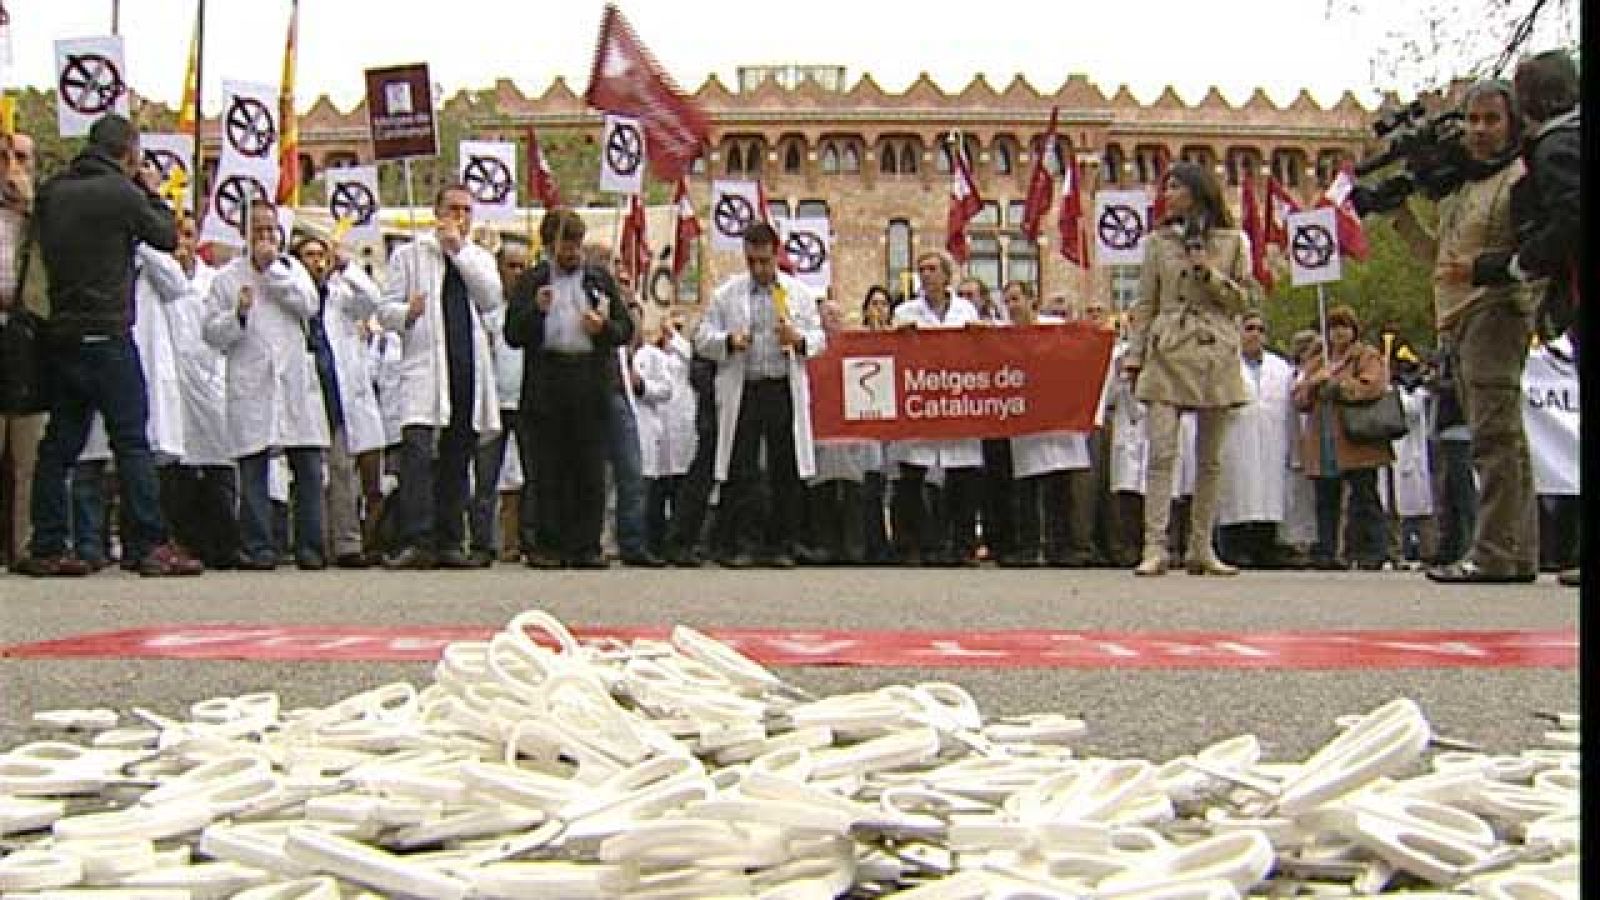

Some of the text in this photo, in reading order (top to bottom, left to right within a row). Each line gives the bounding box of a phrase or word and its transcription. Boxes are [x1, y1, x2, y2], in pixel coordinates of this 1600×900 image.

[904, 365, 1025, 395] Metges de
[904, 394, 1026, 420] Catalunya
